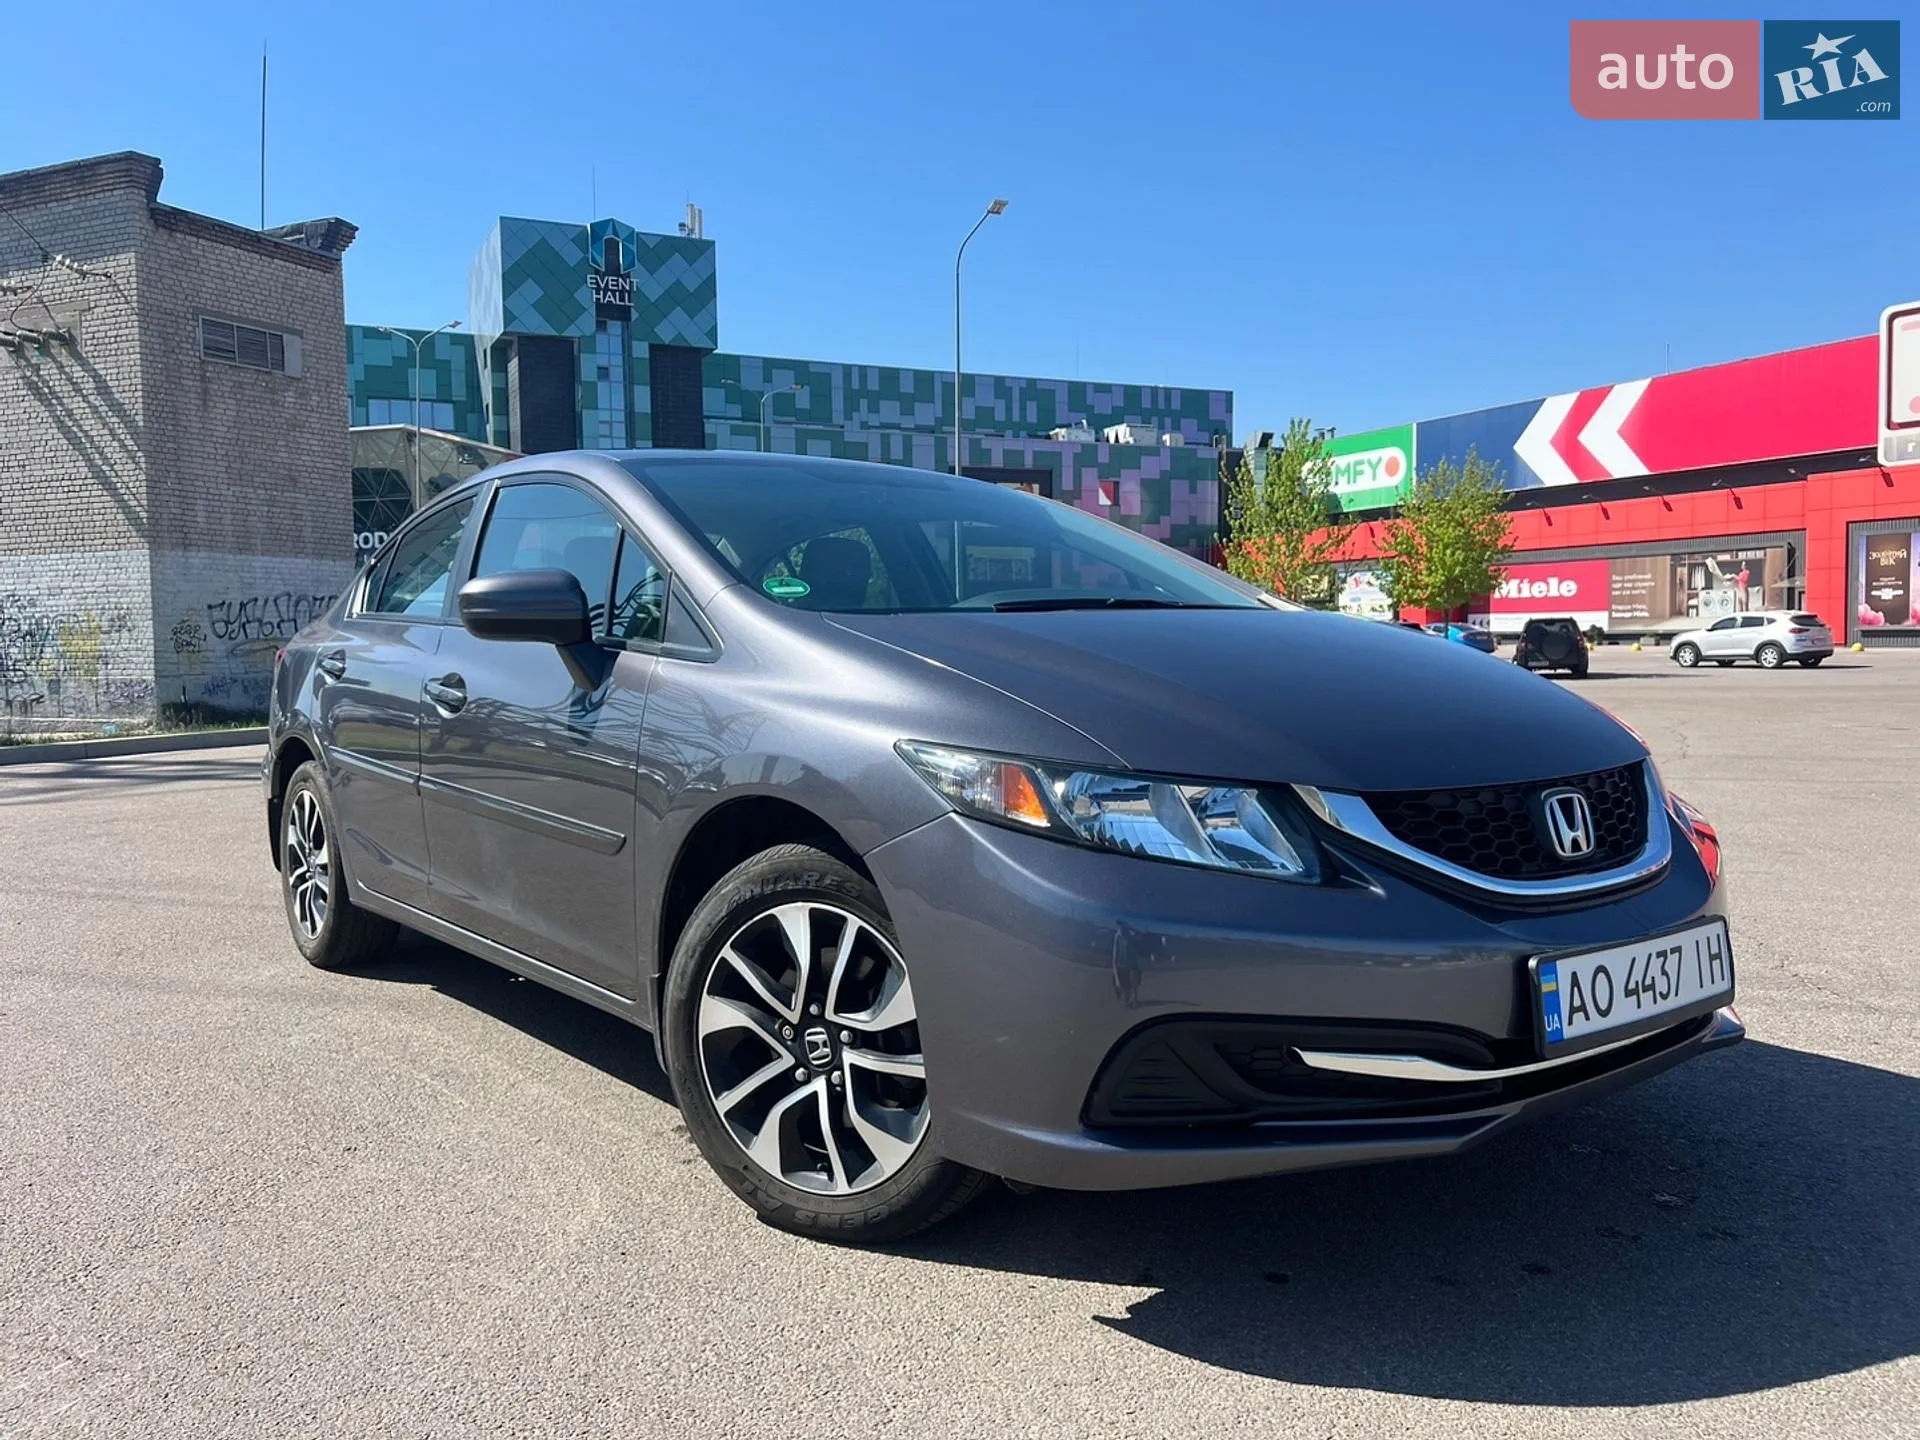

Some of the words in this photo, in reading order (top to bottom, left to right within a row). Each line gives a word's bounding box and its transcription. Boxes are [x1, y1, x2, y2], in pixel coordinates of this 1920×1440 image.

[586, 274, 641, 291] EVENT
[592, 290, 635, 306] HALL
[1493, 576, 1578, 598] Miele
[1567, 964, 1615, 1027] AO
[1623, 945, 1683, 1010] 4437
[1695, 933, 1725, 989] IH
[1544, 1015, 1561, 1032] UA
